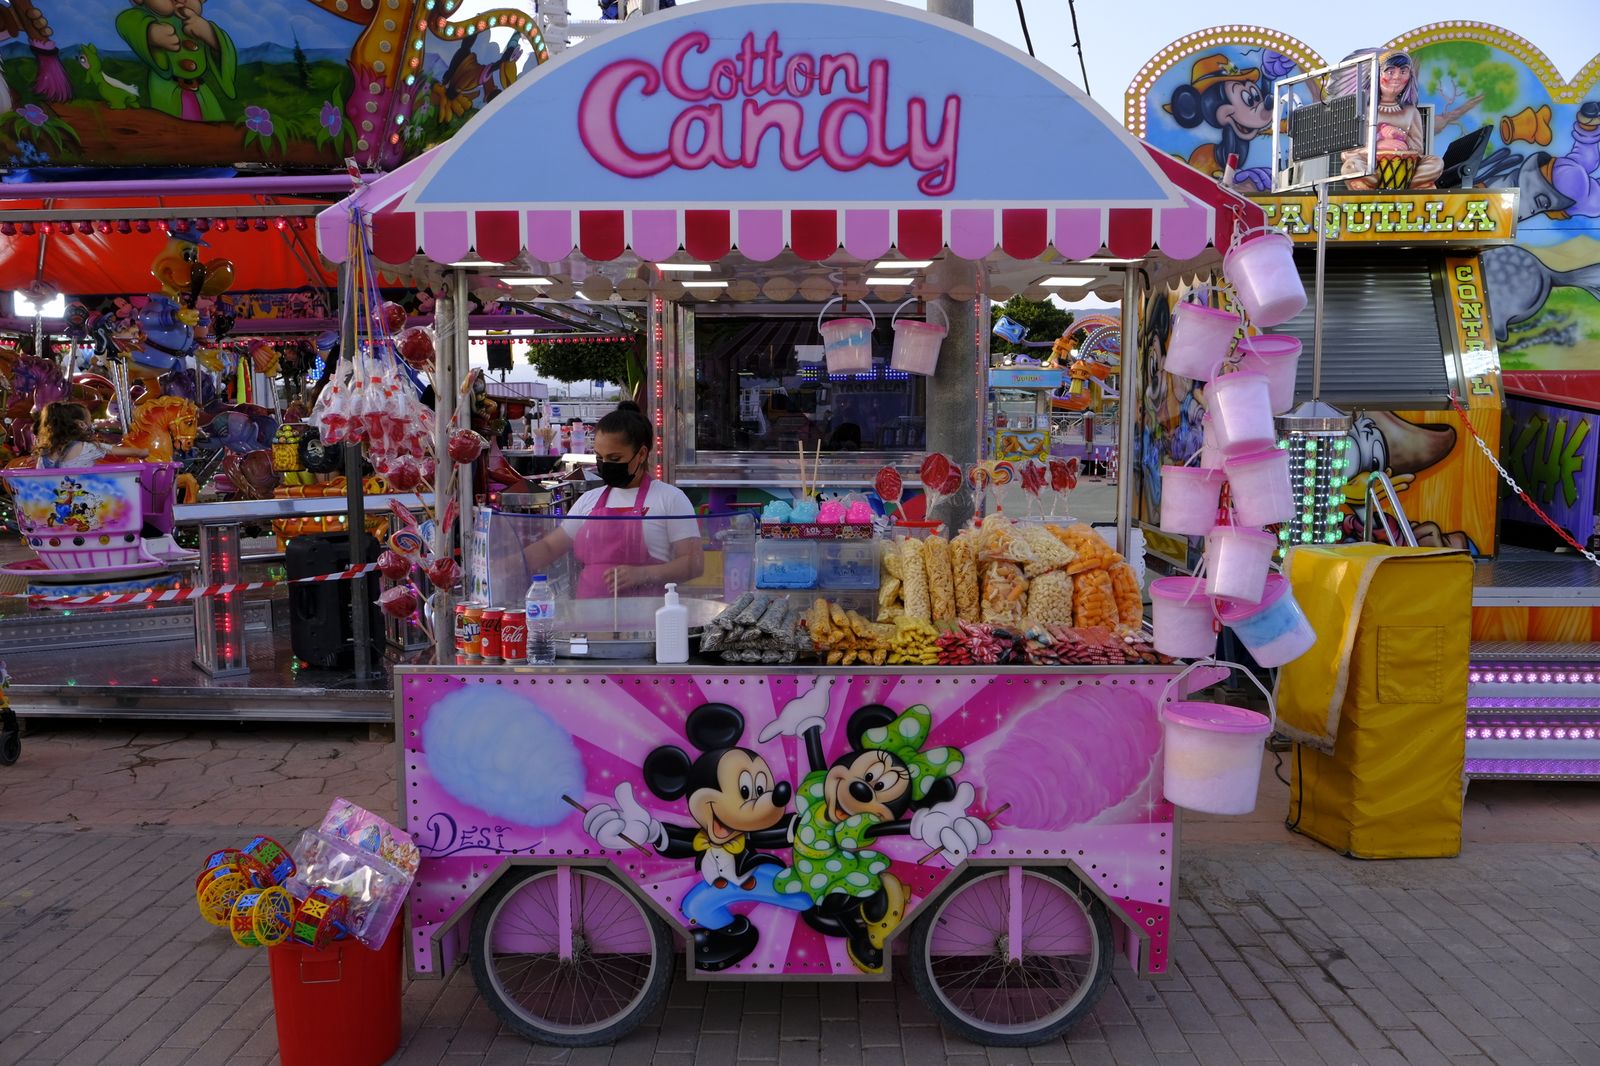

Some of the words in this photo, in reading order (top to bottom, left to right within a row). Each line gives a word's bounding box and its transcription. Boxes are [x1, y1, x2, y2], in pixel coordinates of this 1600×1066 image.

[578, 58, 961, 196] Candy
[662, 30, 867, 101] Cotton
[1455, 265, 1494, 395] CONTRL
